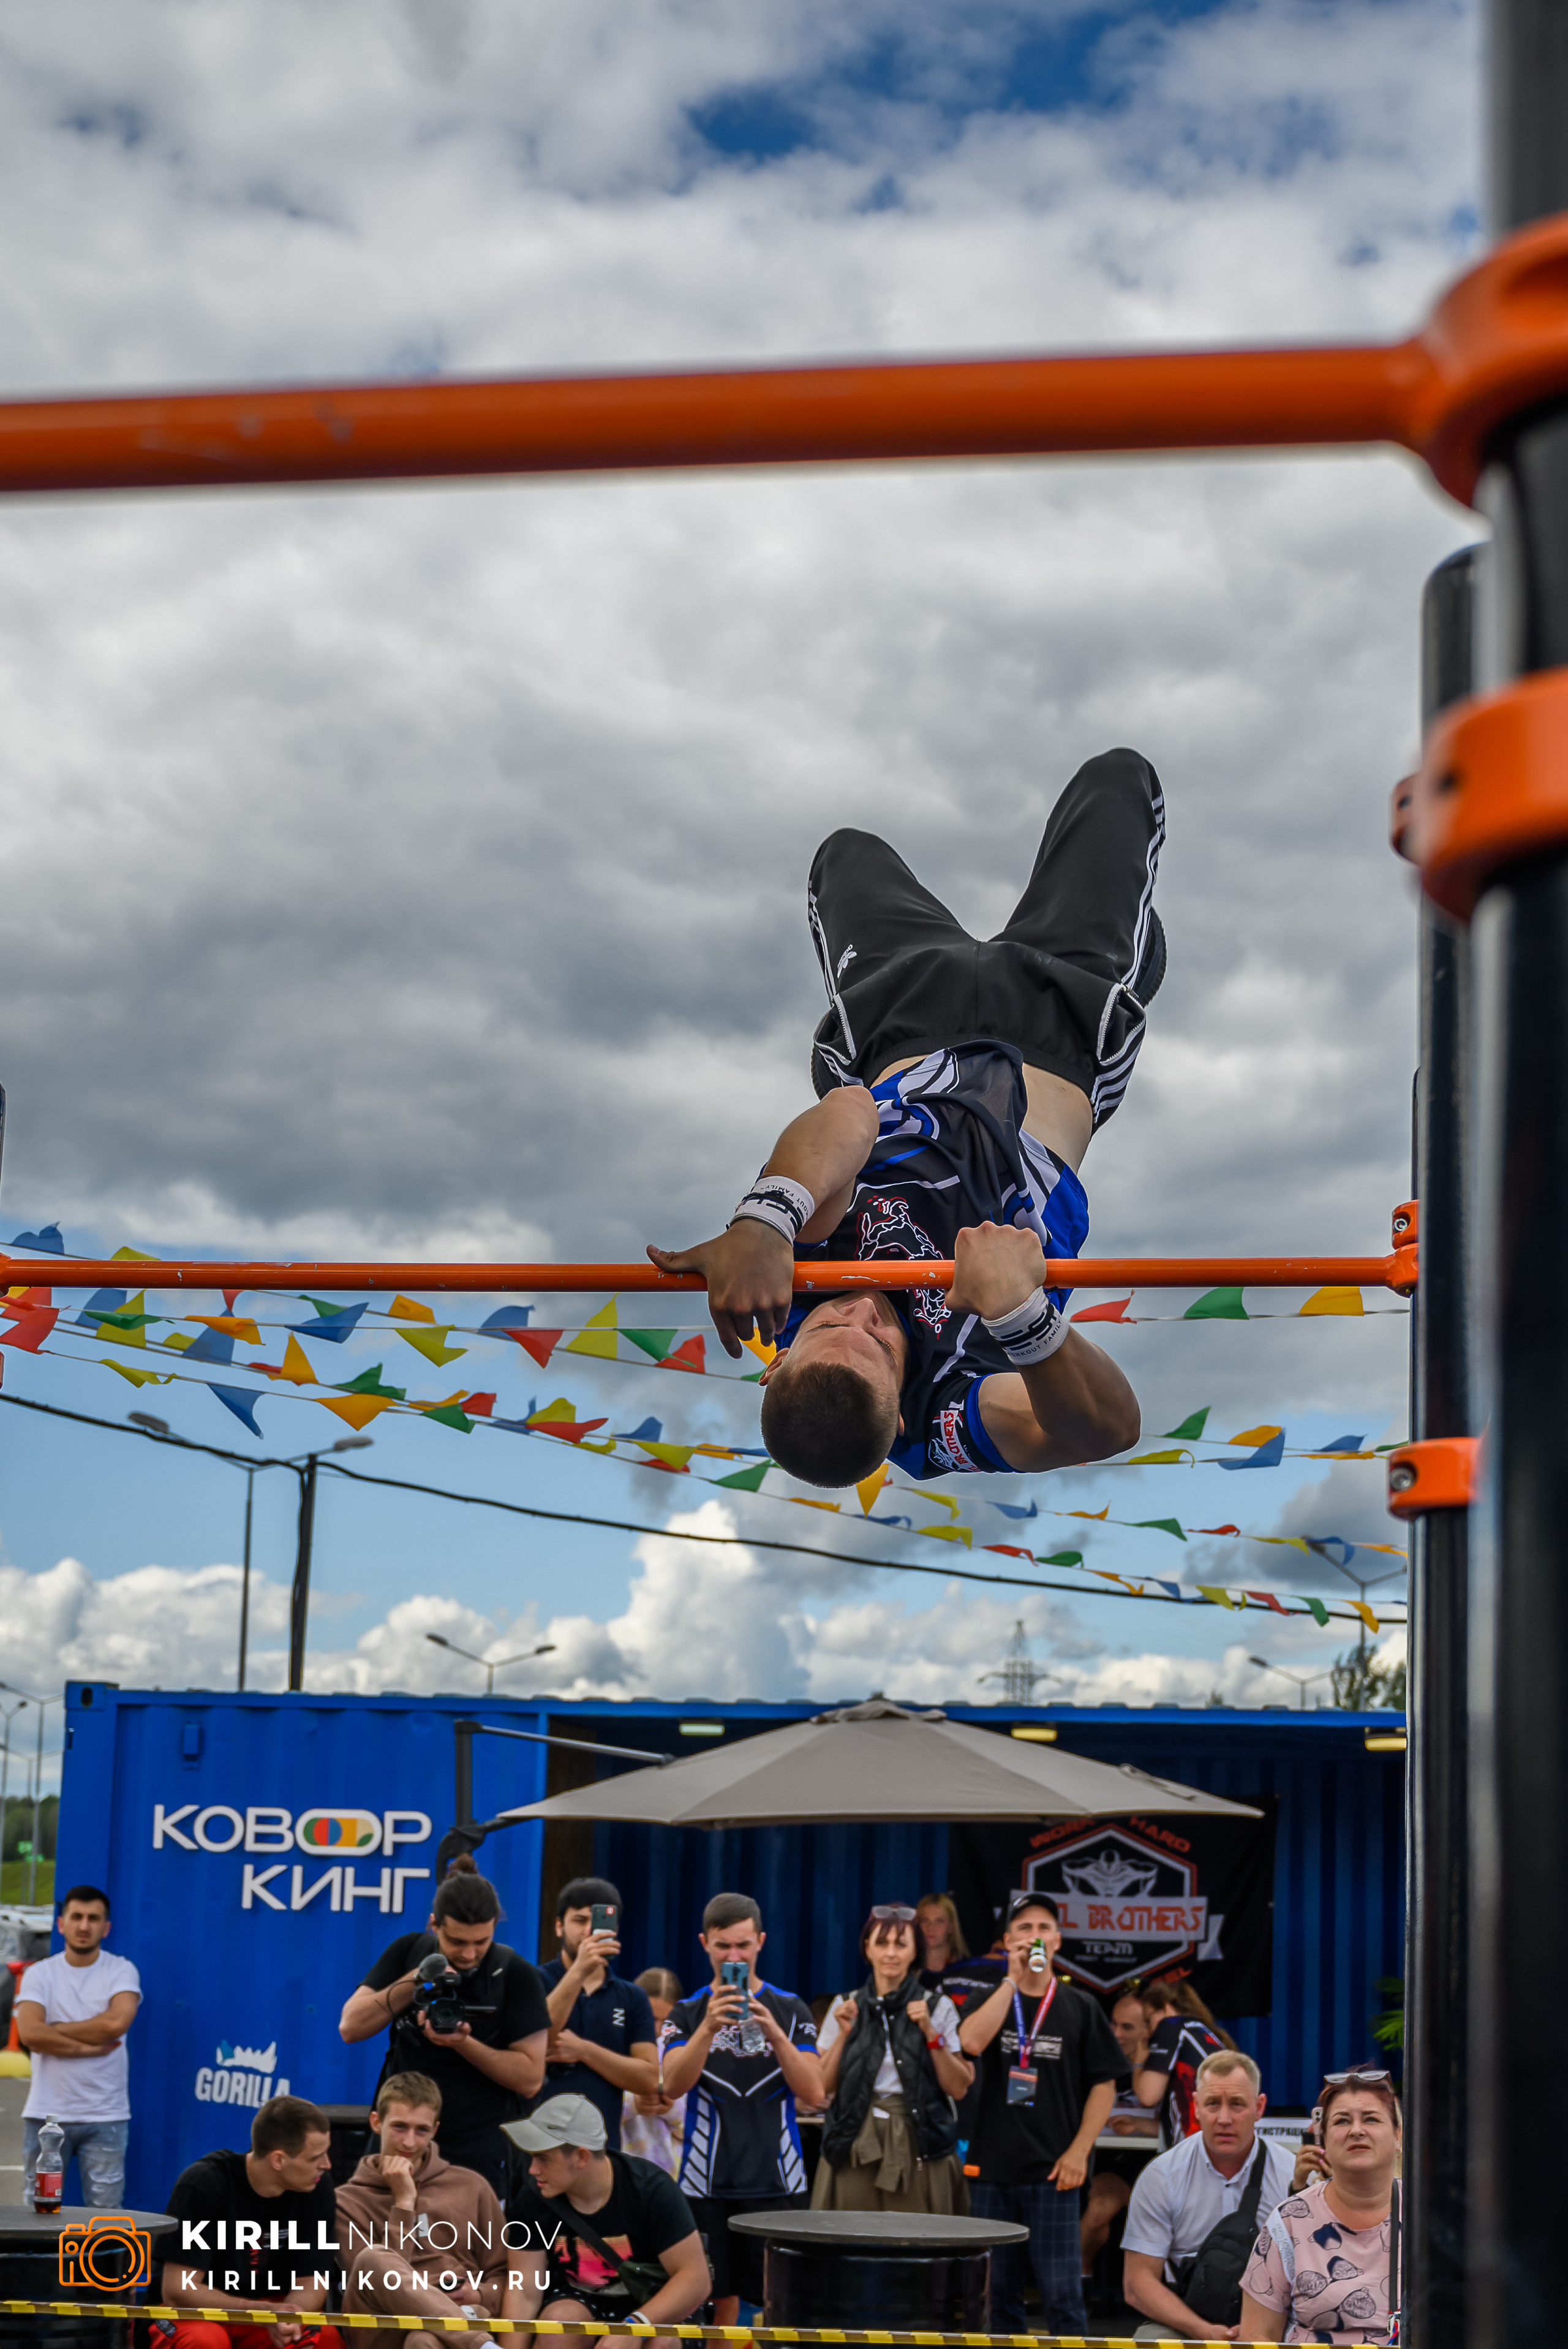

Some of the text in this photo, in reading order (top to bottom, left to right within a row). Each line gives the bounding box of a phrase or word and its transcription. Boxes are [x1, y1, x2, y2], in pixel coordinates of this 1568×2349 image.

[1043, 1320, 1062, 1345] FAMILY
[241, 1864, 431, 1913] КИНГ
[1086, 1904, 1205, 1932] BROTHERS
[1081, 1940, 1134, 1955] TEAM
